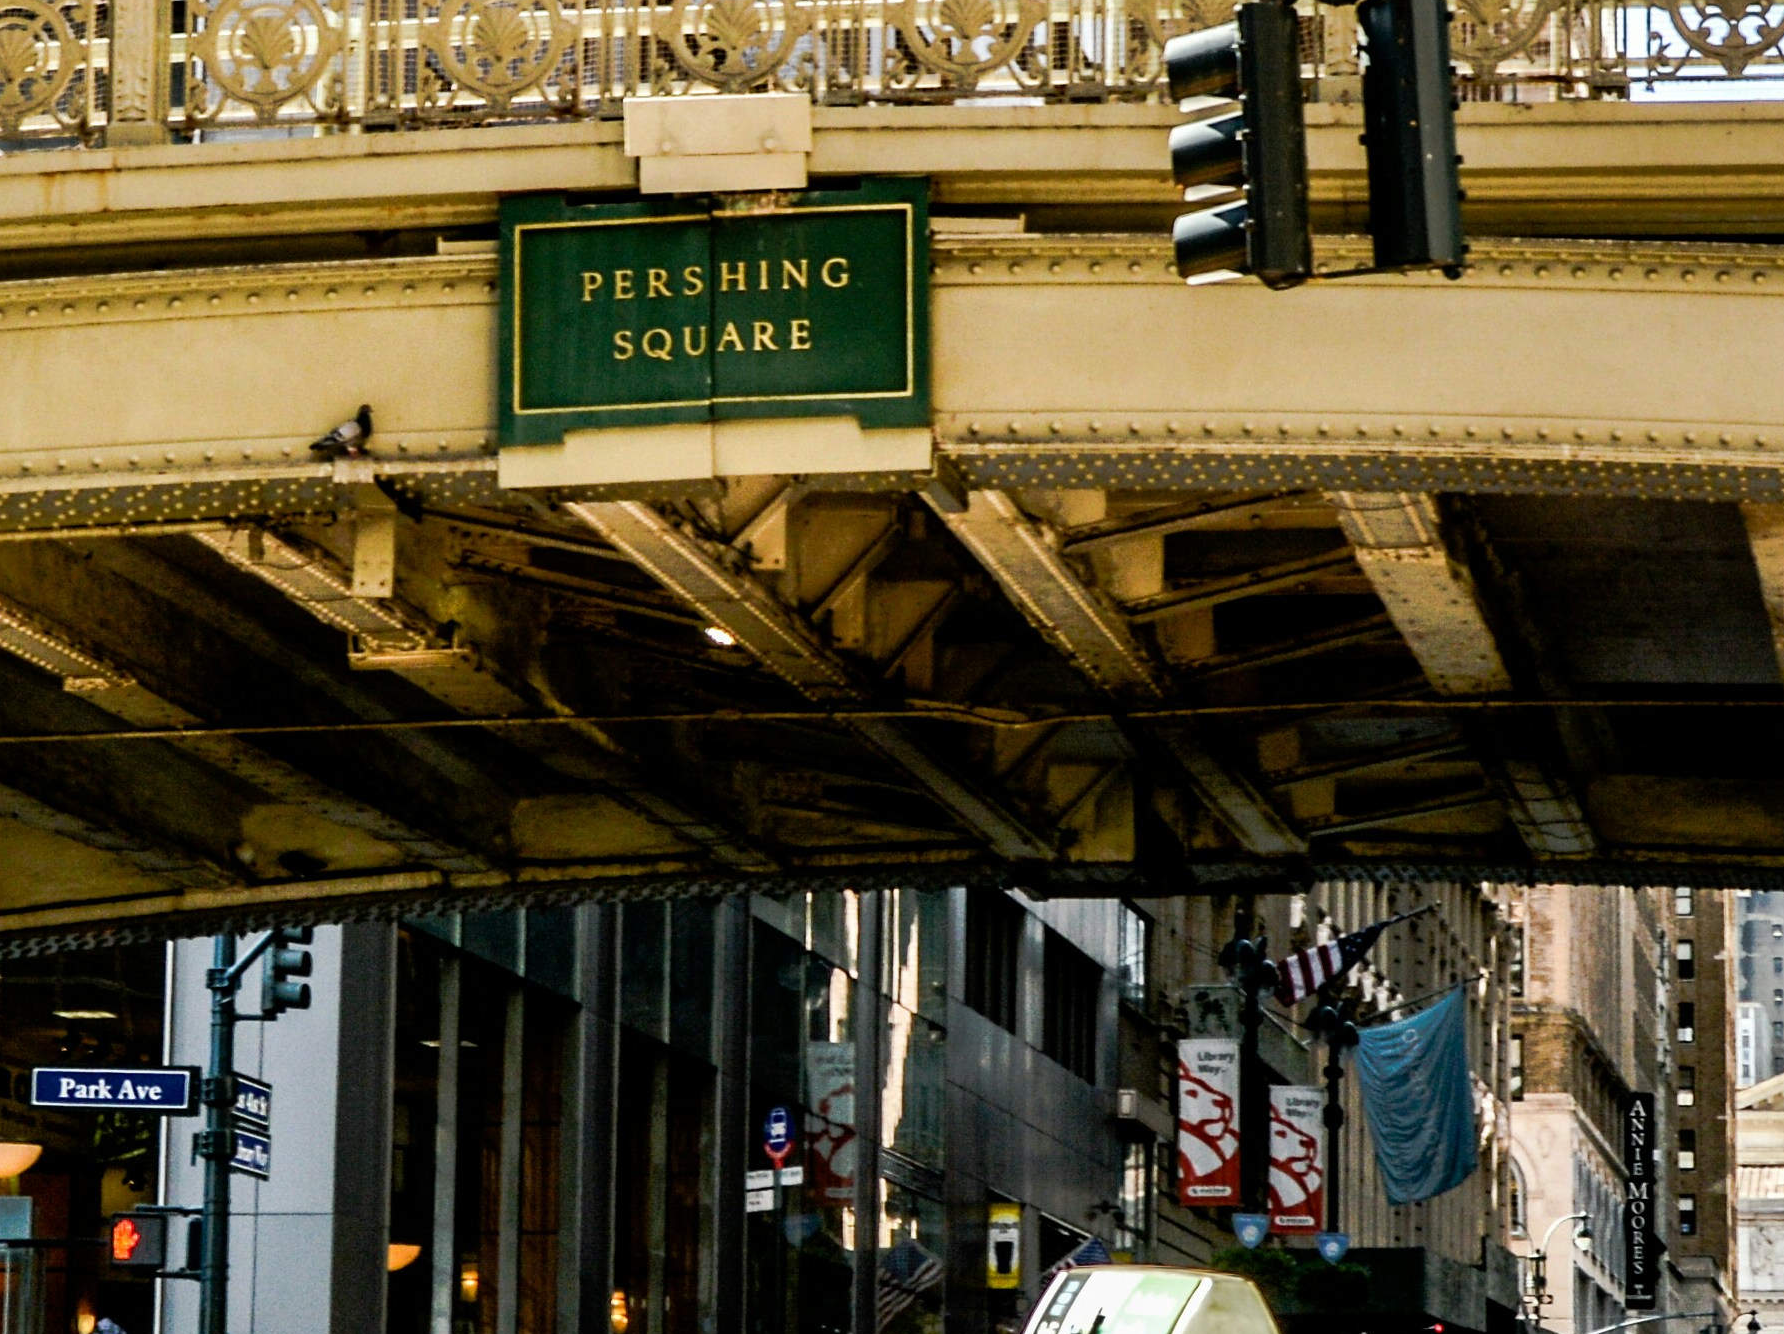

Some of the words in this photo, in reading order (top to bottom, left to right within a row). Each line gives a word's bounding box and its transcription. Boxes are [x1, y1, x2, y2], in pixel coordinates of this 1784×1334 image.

[580, 256, 852, 303] PERSHING
[612, 318, 814, 362] SQUARE
[1197, 1052, 1235, 1064] Library
[58, 1078, 112, 1099] Park
[117, 1079, 162, 1100] Ave
[1629, 1099, 1647, 1176] ANNIE
